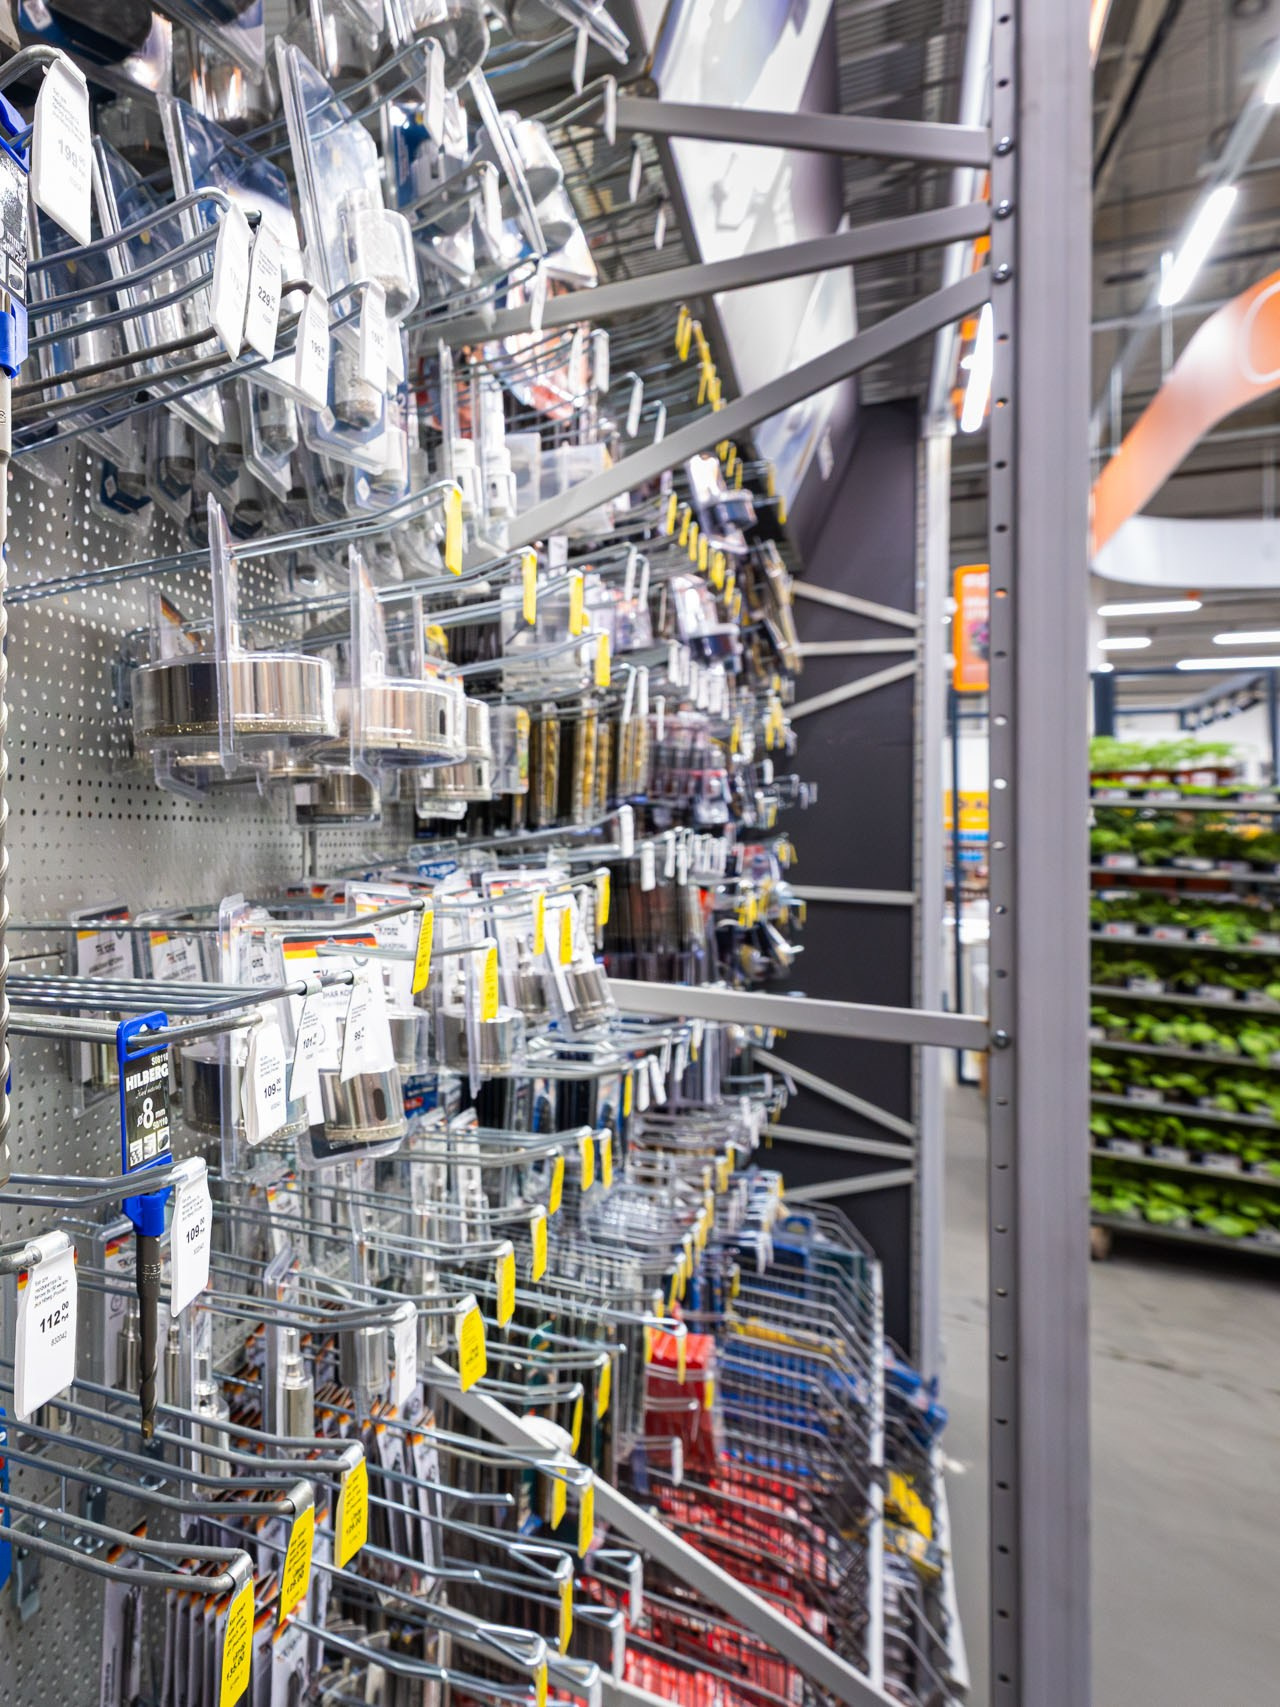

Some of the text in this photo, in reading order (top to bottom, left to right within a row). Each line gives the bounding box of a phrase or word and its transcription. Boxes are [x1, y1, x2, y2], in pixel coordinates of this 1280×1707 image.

[125, 1062, 169, 1092] HILBERG
[264, 1083, 276, 1099] 109
[142, 1097, 154, 1129] 8
[186, 1225, 200, 1244] 109
[40, 1310, 61, 1333] 112
